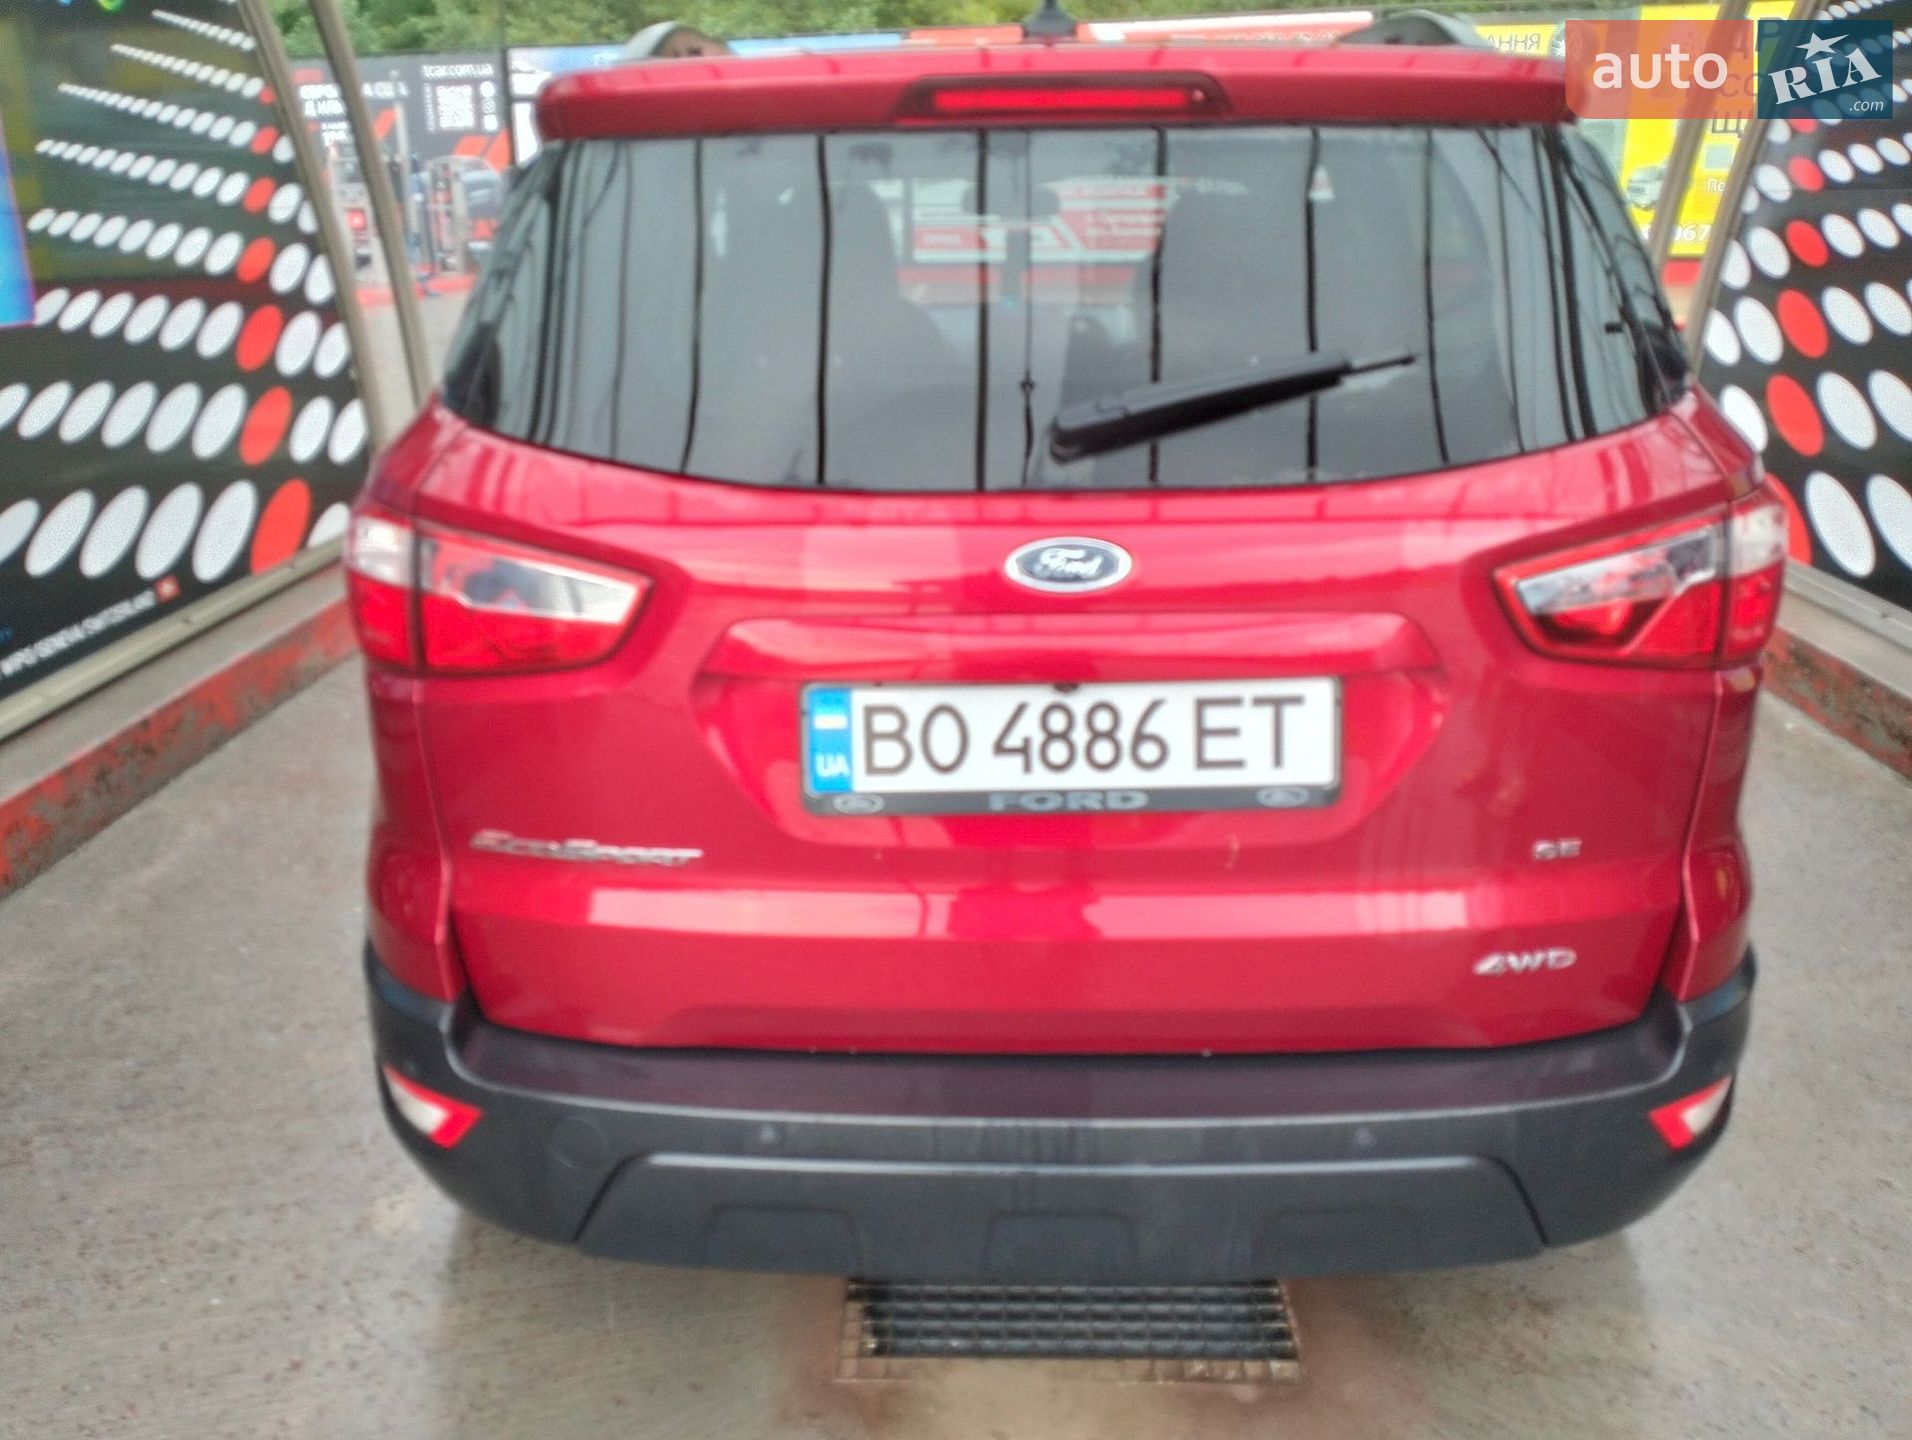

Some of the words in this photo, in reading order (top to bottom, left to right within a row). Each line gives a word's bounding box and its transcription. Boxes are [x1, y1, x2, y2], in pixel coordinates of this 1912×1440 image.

[862, 703, 971, 776] BO
[992, 698, 1170, 775] 4886
[1194, 694, 1305, 771] ET
[815, 752, 850, 778] UA
[988, 789, 1150, 812] FORD
[1474, 948, 1578, 975] 4WD
